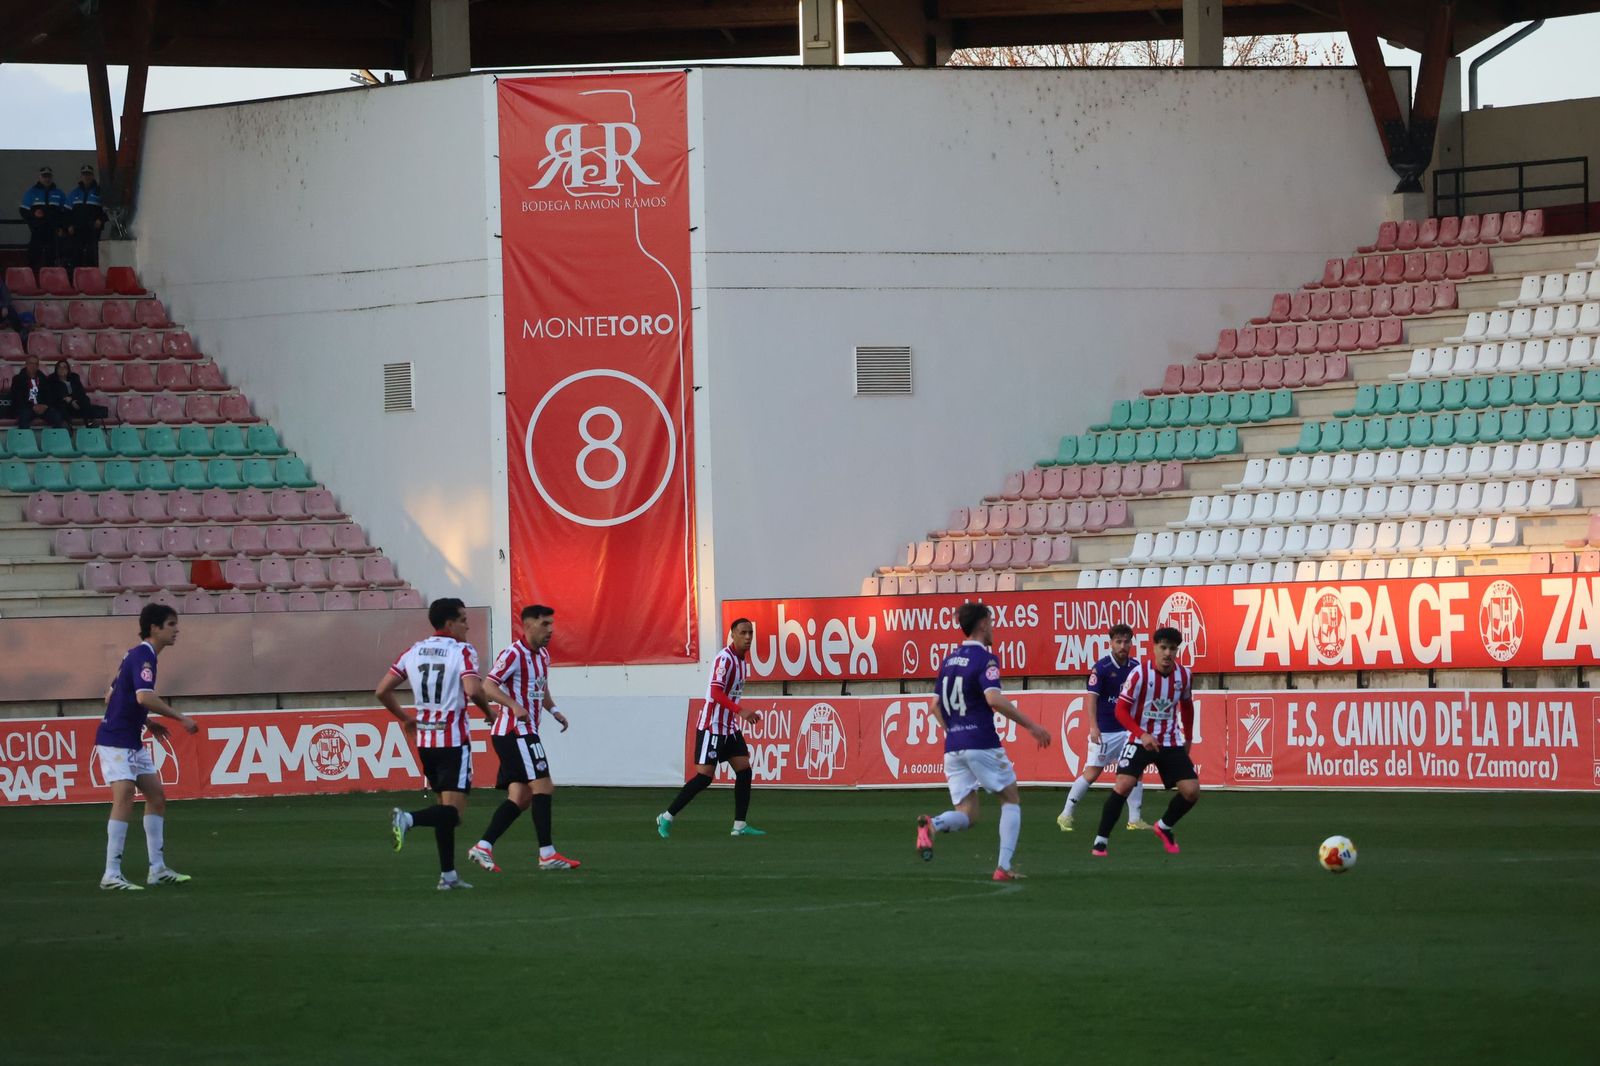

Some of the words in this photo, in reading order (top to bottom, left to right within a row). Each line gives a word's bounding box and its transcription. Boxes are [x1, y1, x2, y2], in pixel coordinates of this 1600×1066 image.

[521, 201, 571, 213] BODEGA
[574, 198, 621, 211] RAMON
[624, 196, 667, 209] RAMOS
[522, 313, 675, 339] MONTETORO
[575, 405, 627, 490] 8
[883, 598, 1039, 632] www.cuex.es
[1053, 592, 1149, 631] FUNDACIÓN
[1233, 585, 1404, 667] ZAMORA
[1408, 581, 1470, 664] CF
[1540, 576, 1600, 660] ZA
[727, 604, 878, 677] ubiex
[417, 663, 446, 704] 17
[942, 676, 967, 717] 14
[711, 735, 718, 749] 4
[1287, 701, 1325, 747] E.S.
[1332, 700, 1427, 747] CAMINO
[1435, 700, 1463, 747] DE
[1470, 700, 1500, 747] LA
[1507, 701, 1579, 748] PLATA
[207, 721, 421, 785] ZAMORA
[530, 742, 545, 760] 10
[910, 763, 944, 774] GOODLIF
[1122, 743, 1138, 759] 19
[1306, 751, 1379, 777] Morales
[1384, 750, 1413, 777] del
[1418, 752, 1460, 778] Vino
[1466, 752, 1559, 781] (Zamora)
